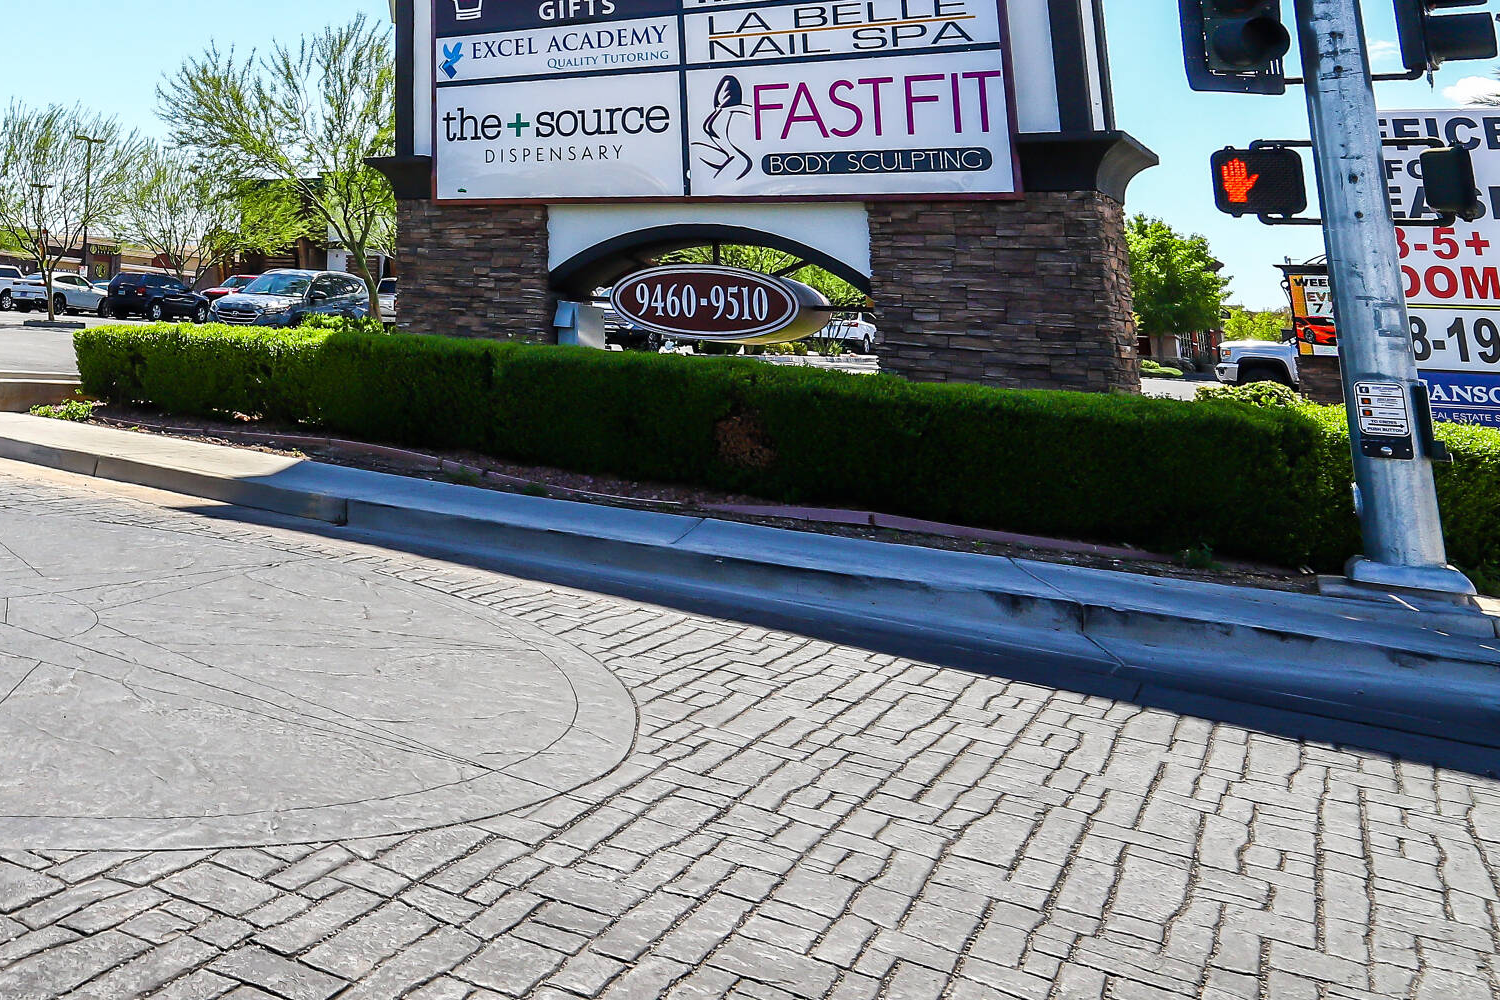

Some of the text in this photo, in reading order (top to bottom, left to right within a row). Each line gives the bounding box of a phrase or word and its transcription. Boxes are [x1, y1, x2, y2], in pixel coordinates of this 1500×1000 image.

[708, 11, 772, 35] LA
[471, 24, 668, 60] EXCEL ACADEMY
[709, 21, 974, 60] NAIL SPA
[547, 50, 669, 70] QUALITY TUTORING
[485, 144, 623, 164] DISPENSARY
[770, 149, 983, 173] BODY SCULPTING
[635, 282, 769, 321] 9460-9510
